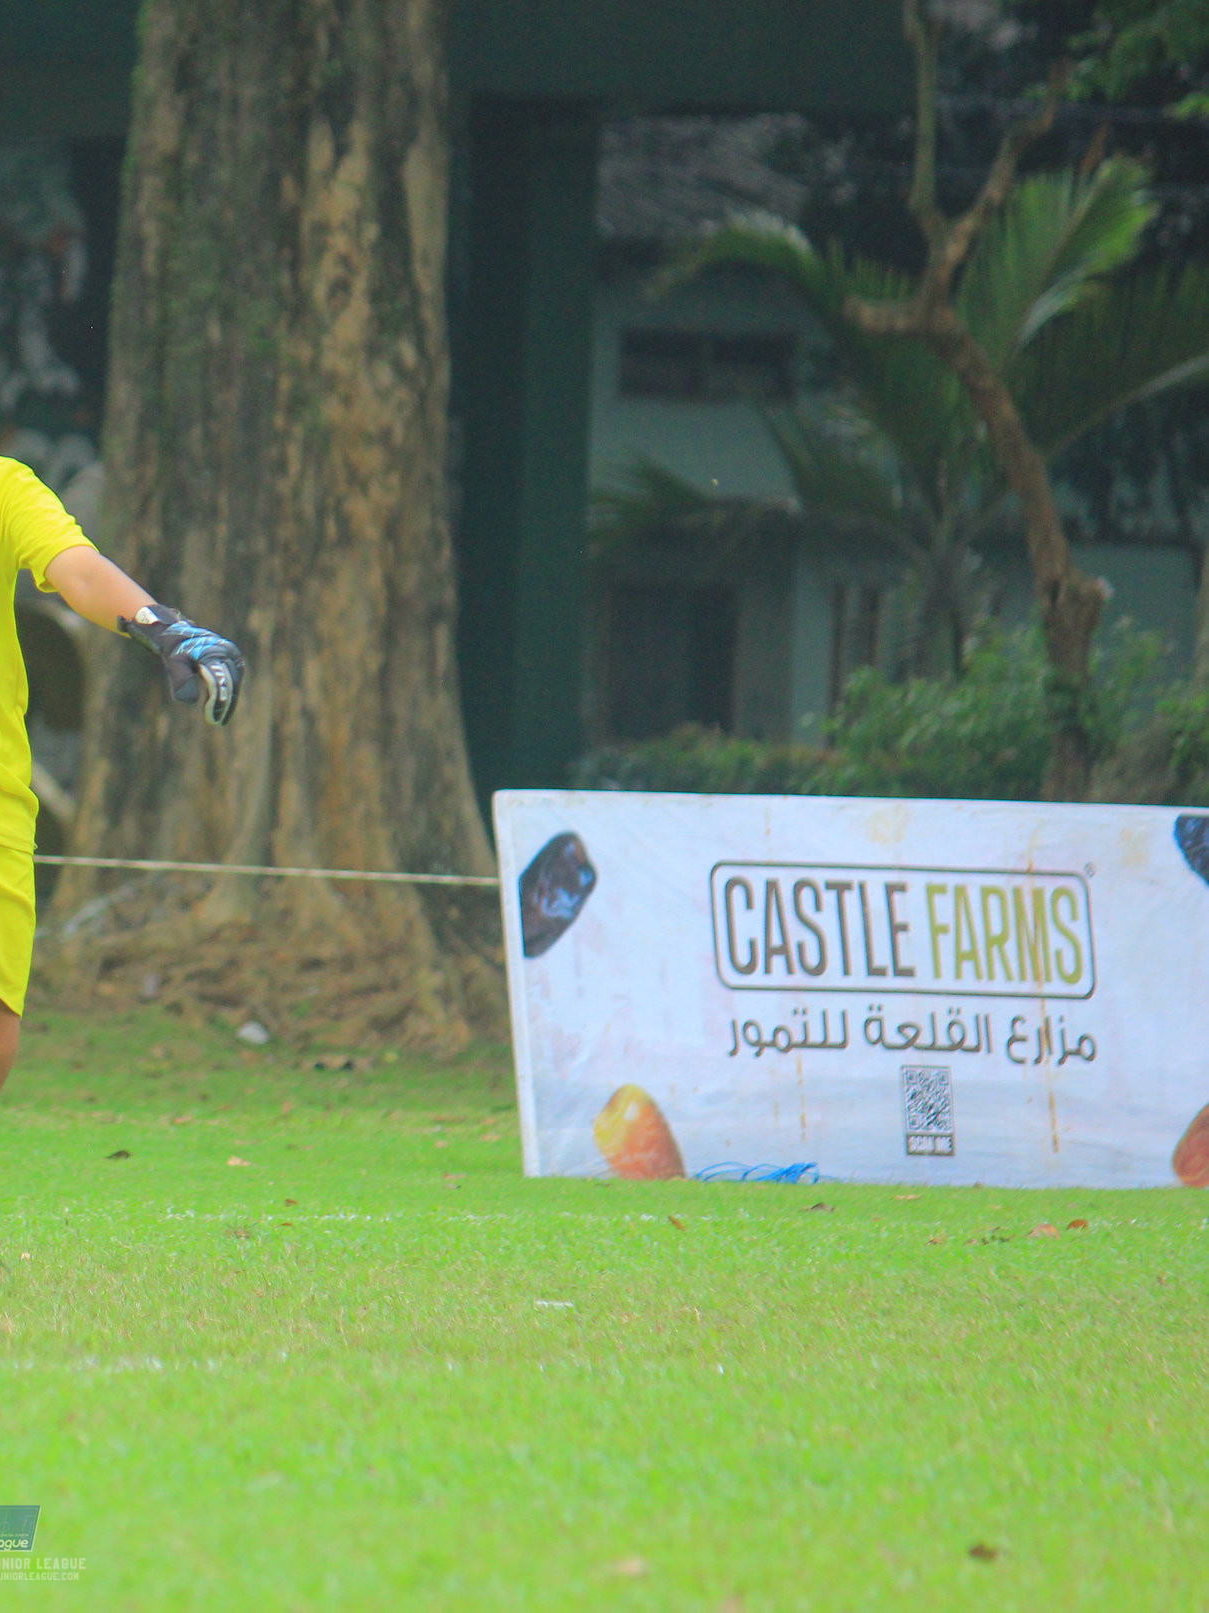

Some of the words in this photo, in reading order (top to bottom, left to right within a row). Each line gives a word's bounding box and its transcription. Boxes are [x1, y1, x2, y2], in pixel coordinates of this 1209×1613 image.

[724, 875, 917, 977] CASTLE
[925, 882, 1084, 985] FARMS
[727, 1007, 849, 1058] للتمور
[863, 1003, 994, 1054] القلعة
[1005, 1014, 1098, 1066] مزارع
